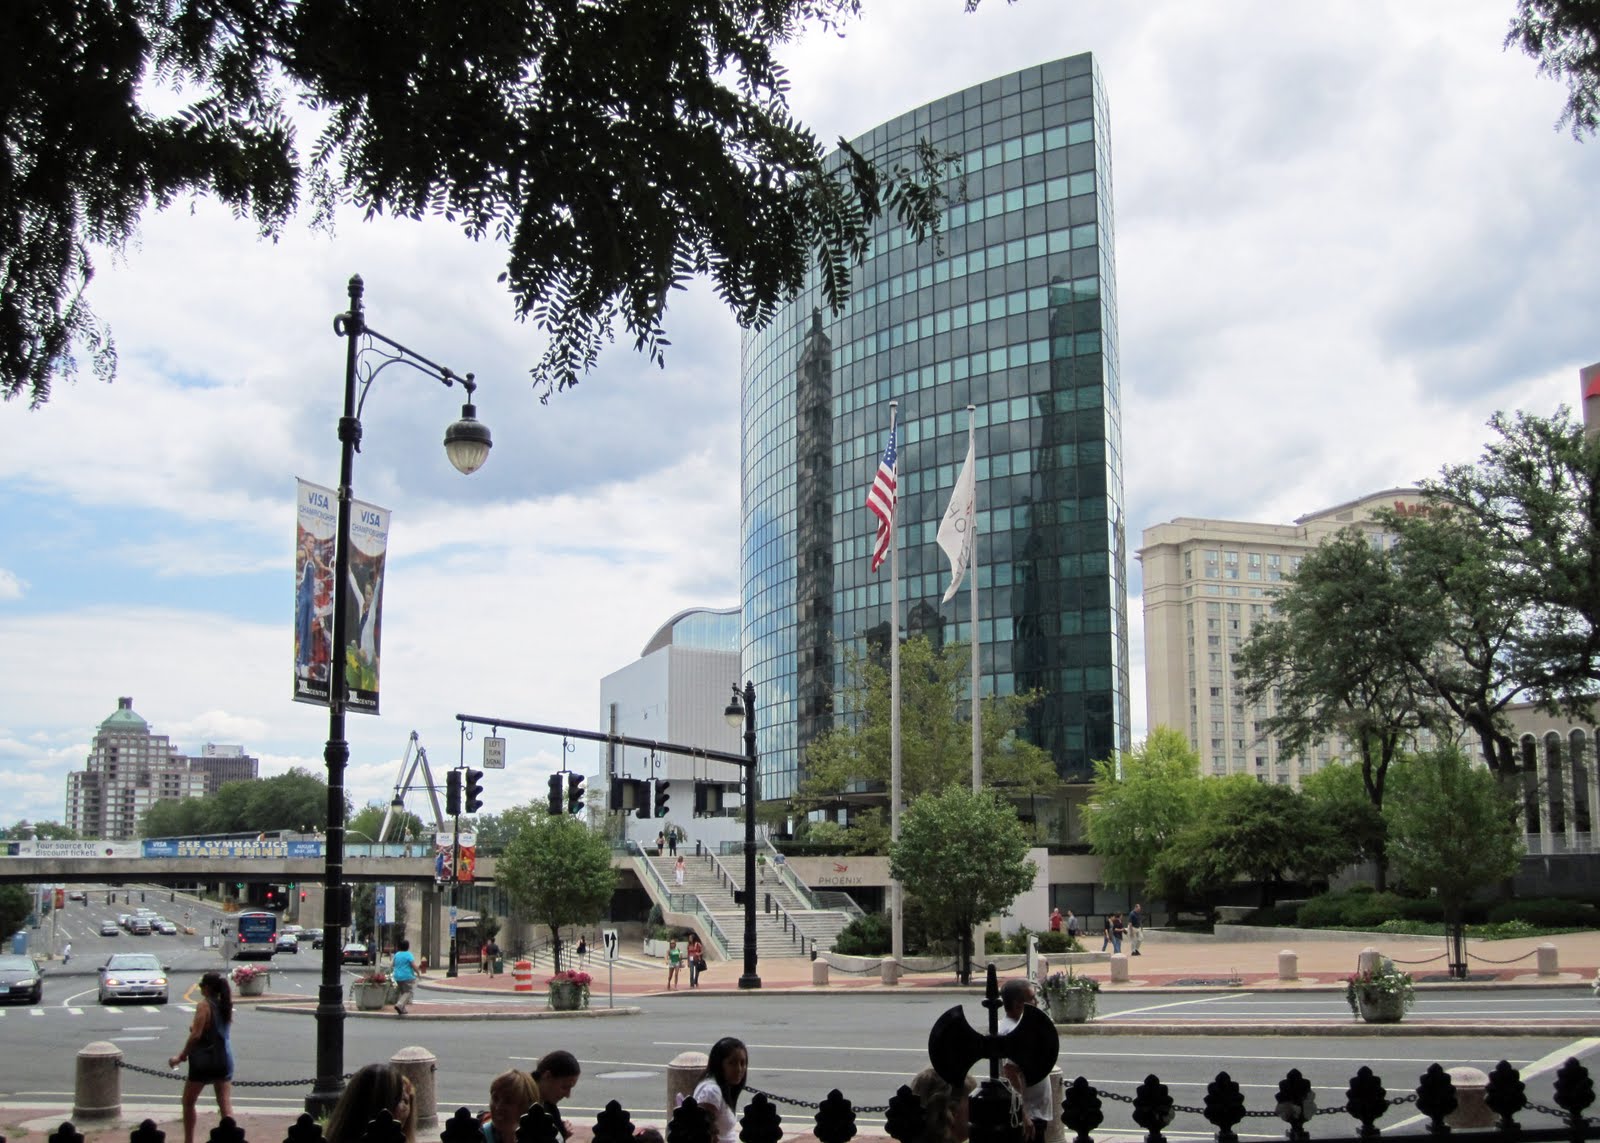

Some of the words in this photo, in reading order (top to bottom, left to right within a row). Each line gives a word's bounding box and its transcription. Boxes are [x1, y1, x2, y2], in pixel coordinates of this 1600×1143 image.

[308, 492, 329, 510] VISA
[361, 511, 381, 527] VISA
[310, 688, 328, 698] CENTER
[359, 697, 377, 706] CENTER
[177, 848, 230, 856] STARS
[233, 848, 288, 856] SHINE!
[818, 877, 862, 885] PHOENIX
